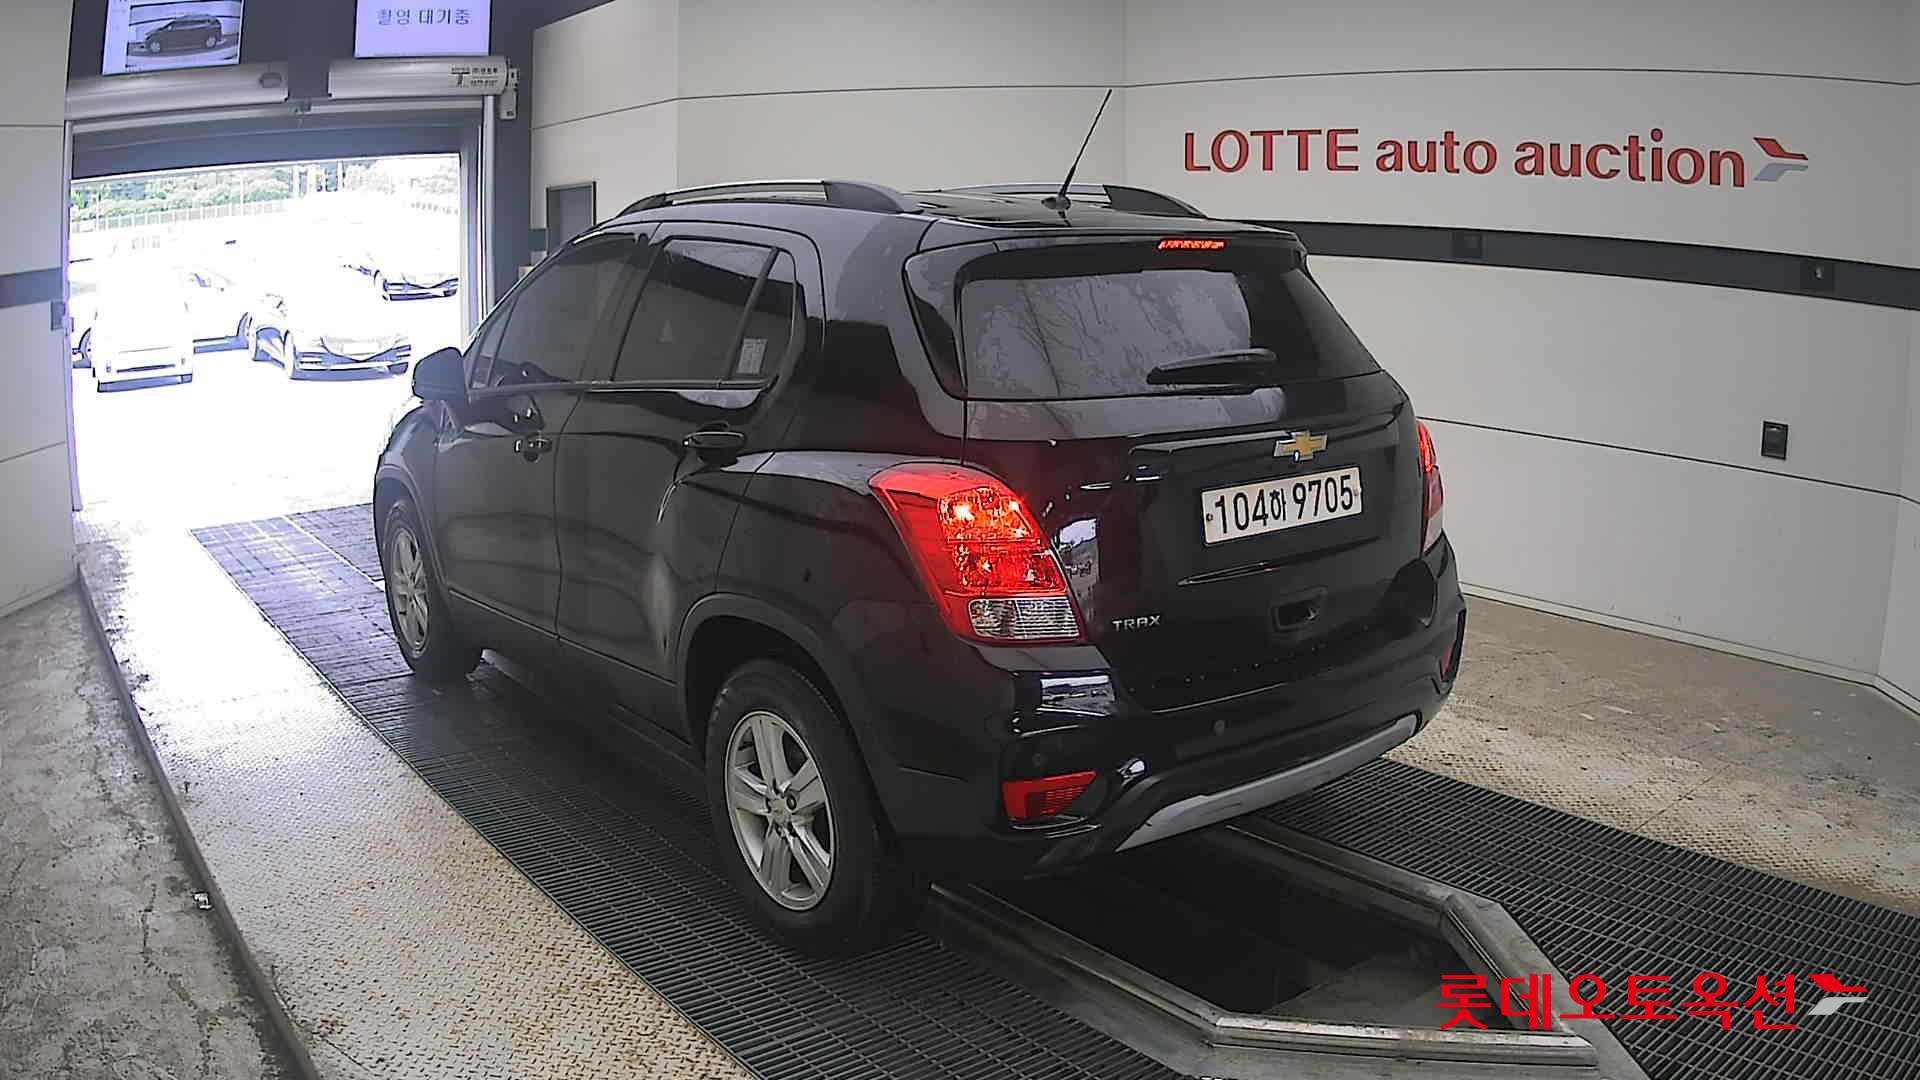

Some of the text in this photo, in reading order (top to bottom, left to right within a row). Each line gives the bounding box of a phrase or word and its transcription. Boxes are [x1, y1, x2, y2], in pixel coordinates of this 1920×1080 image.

[419, 8, 469, 25] 대기중
[1184, 128, 1746, 188] LOTTE auto auction
[1215, 475, 1353, 534] 104하 9705
[1111, 614, 1161, 632] TRAX
